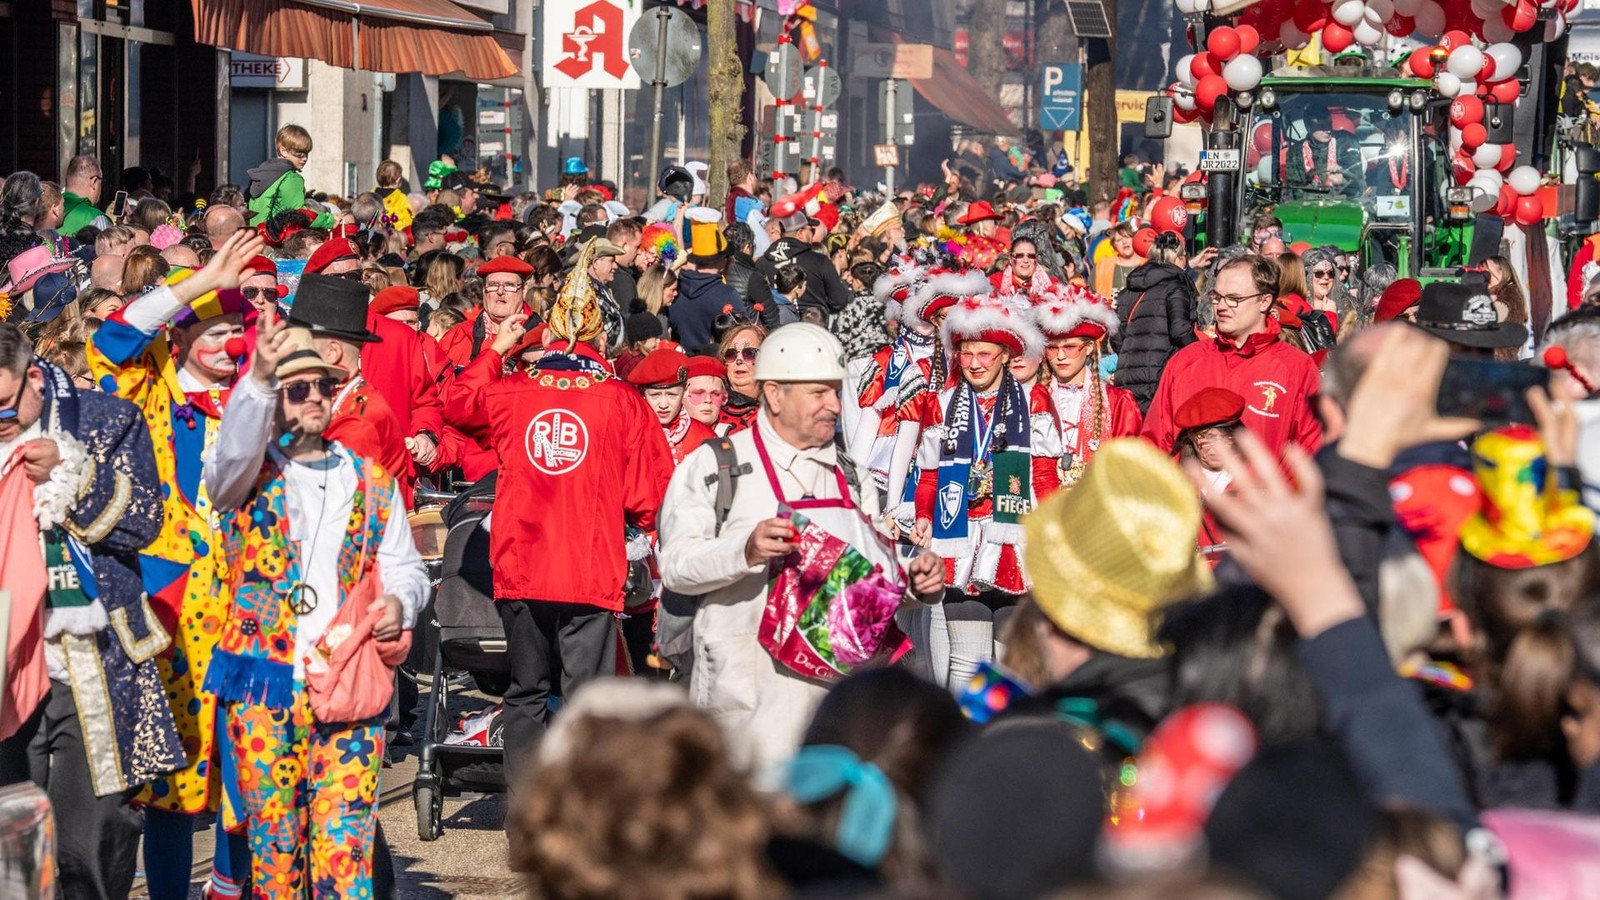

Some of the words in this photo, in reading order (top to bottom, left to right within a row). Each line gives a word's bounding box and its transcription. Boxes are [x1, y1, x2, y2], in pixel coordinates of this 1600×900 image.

[232, 63, 282, 75] THEKE
[1044, 66, 1064, 96] P
[1207, 152, 1219, 160] EN
[1387, 200, 1394, 211] 7
[996, 494, 1031, 515] FIEGE
